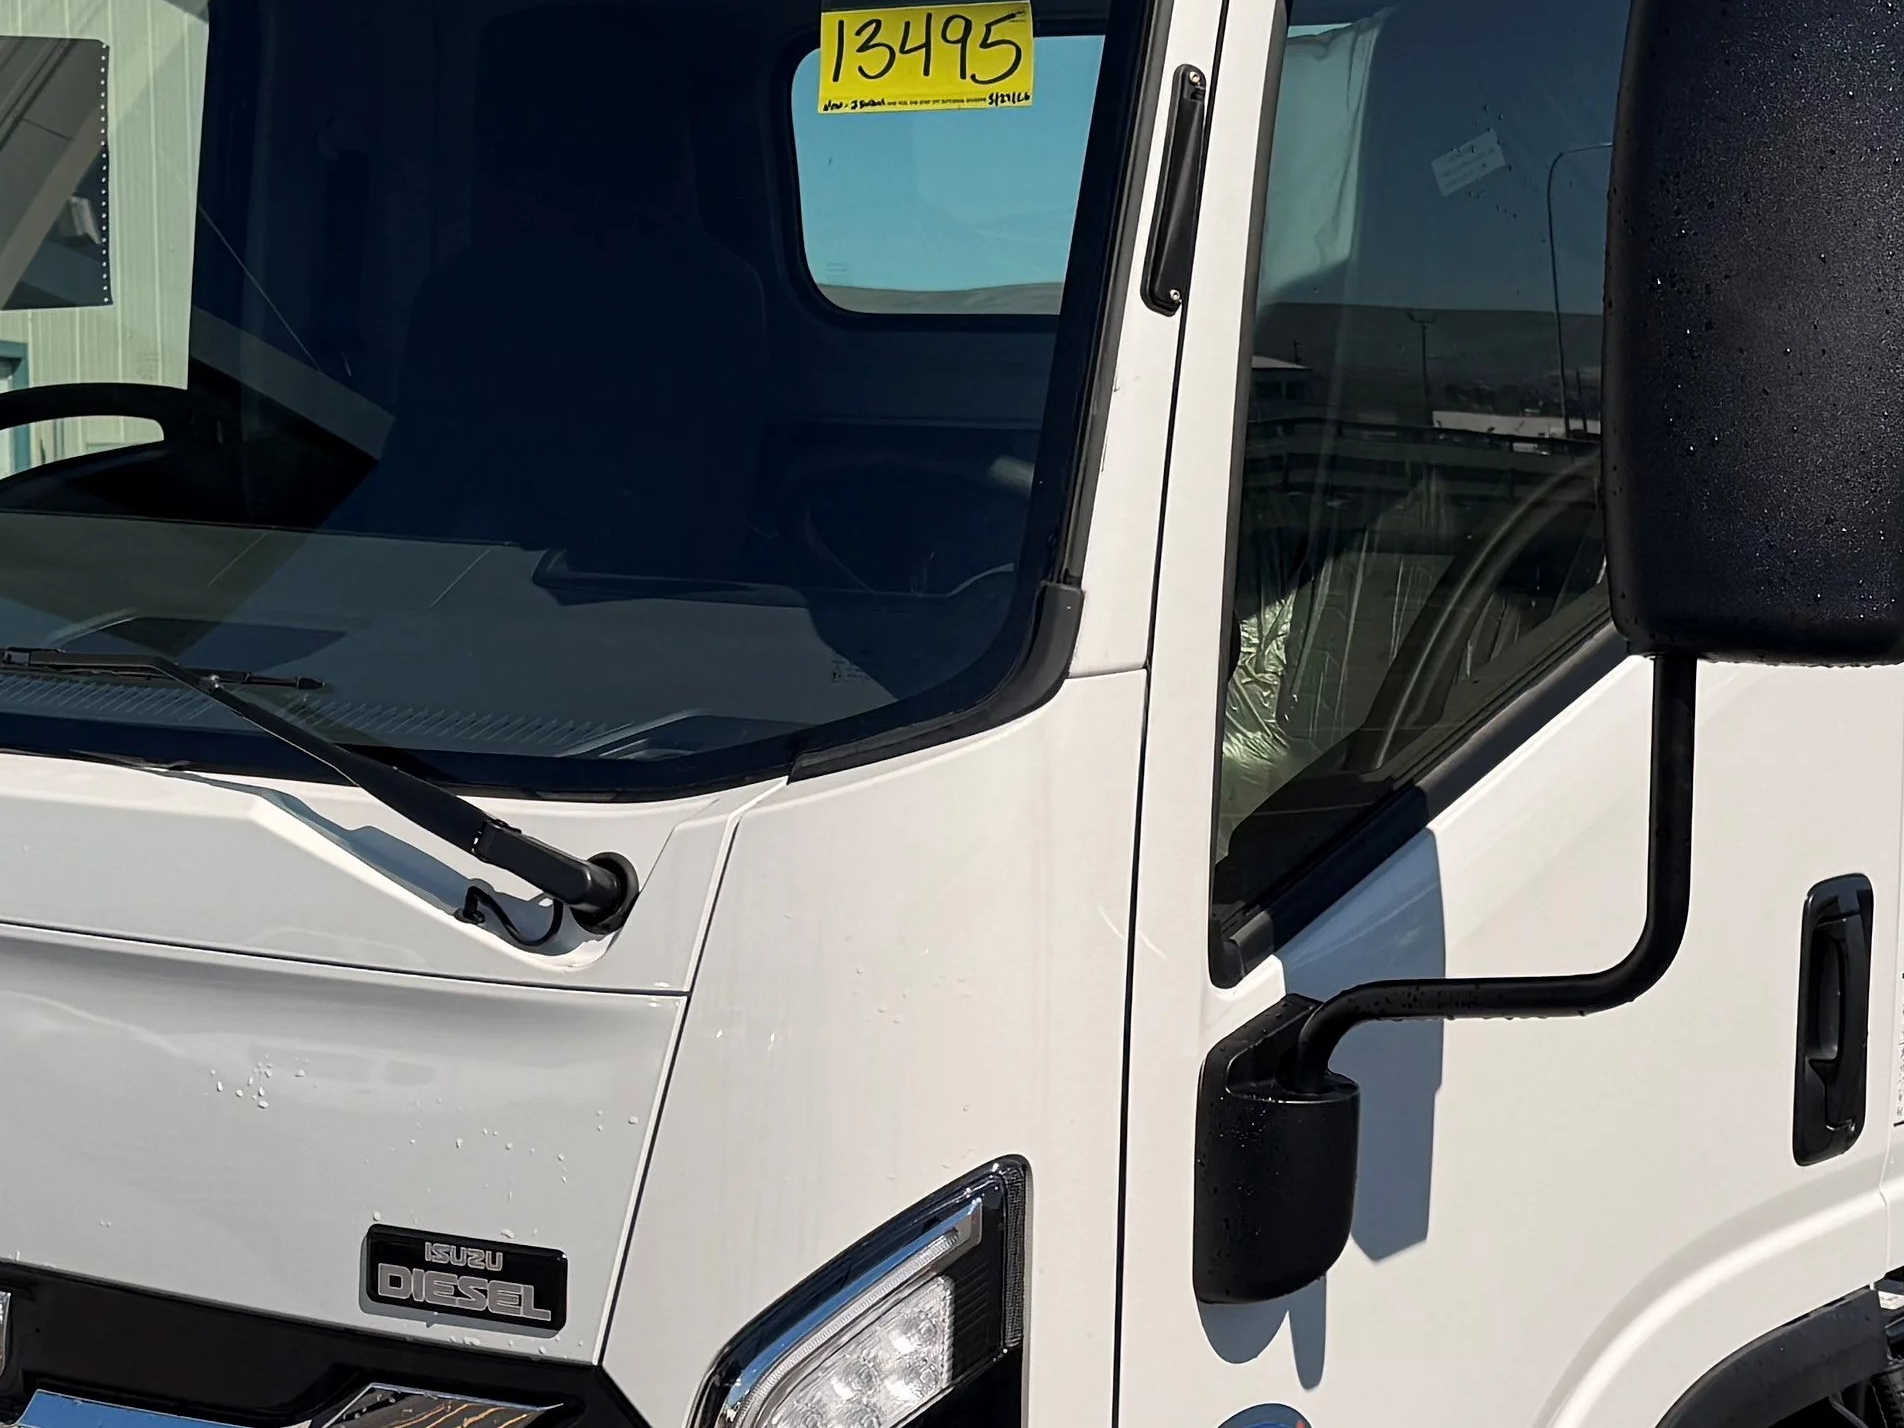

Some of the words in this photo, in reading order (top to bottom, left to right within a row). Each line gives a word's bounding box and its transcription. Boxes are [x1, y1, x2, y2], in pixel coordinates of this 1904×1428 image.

[832, 12, 1023, 85] 13495
[425, 1242, 503, 1271] ISUZU
[378, 1263, 551, 1321] DIESEL
